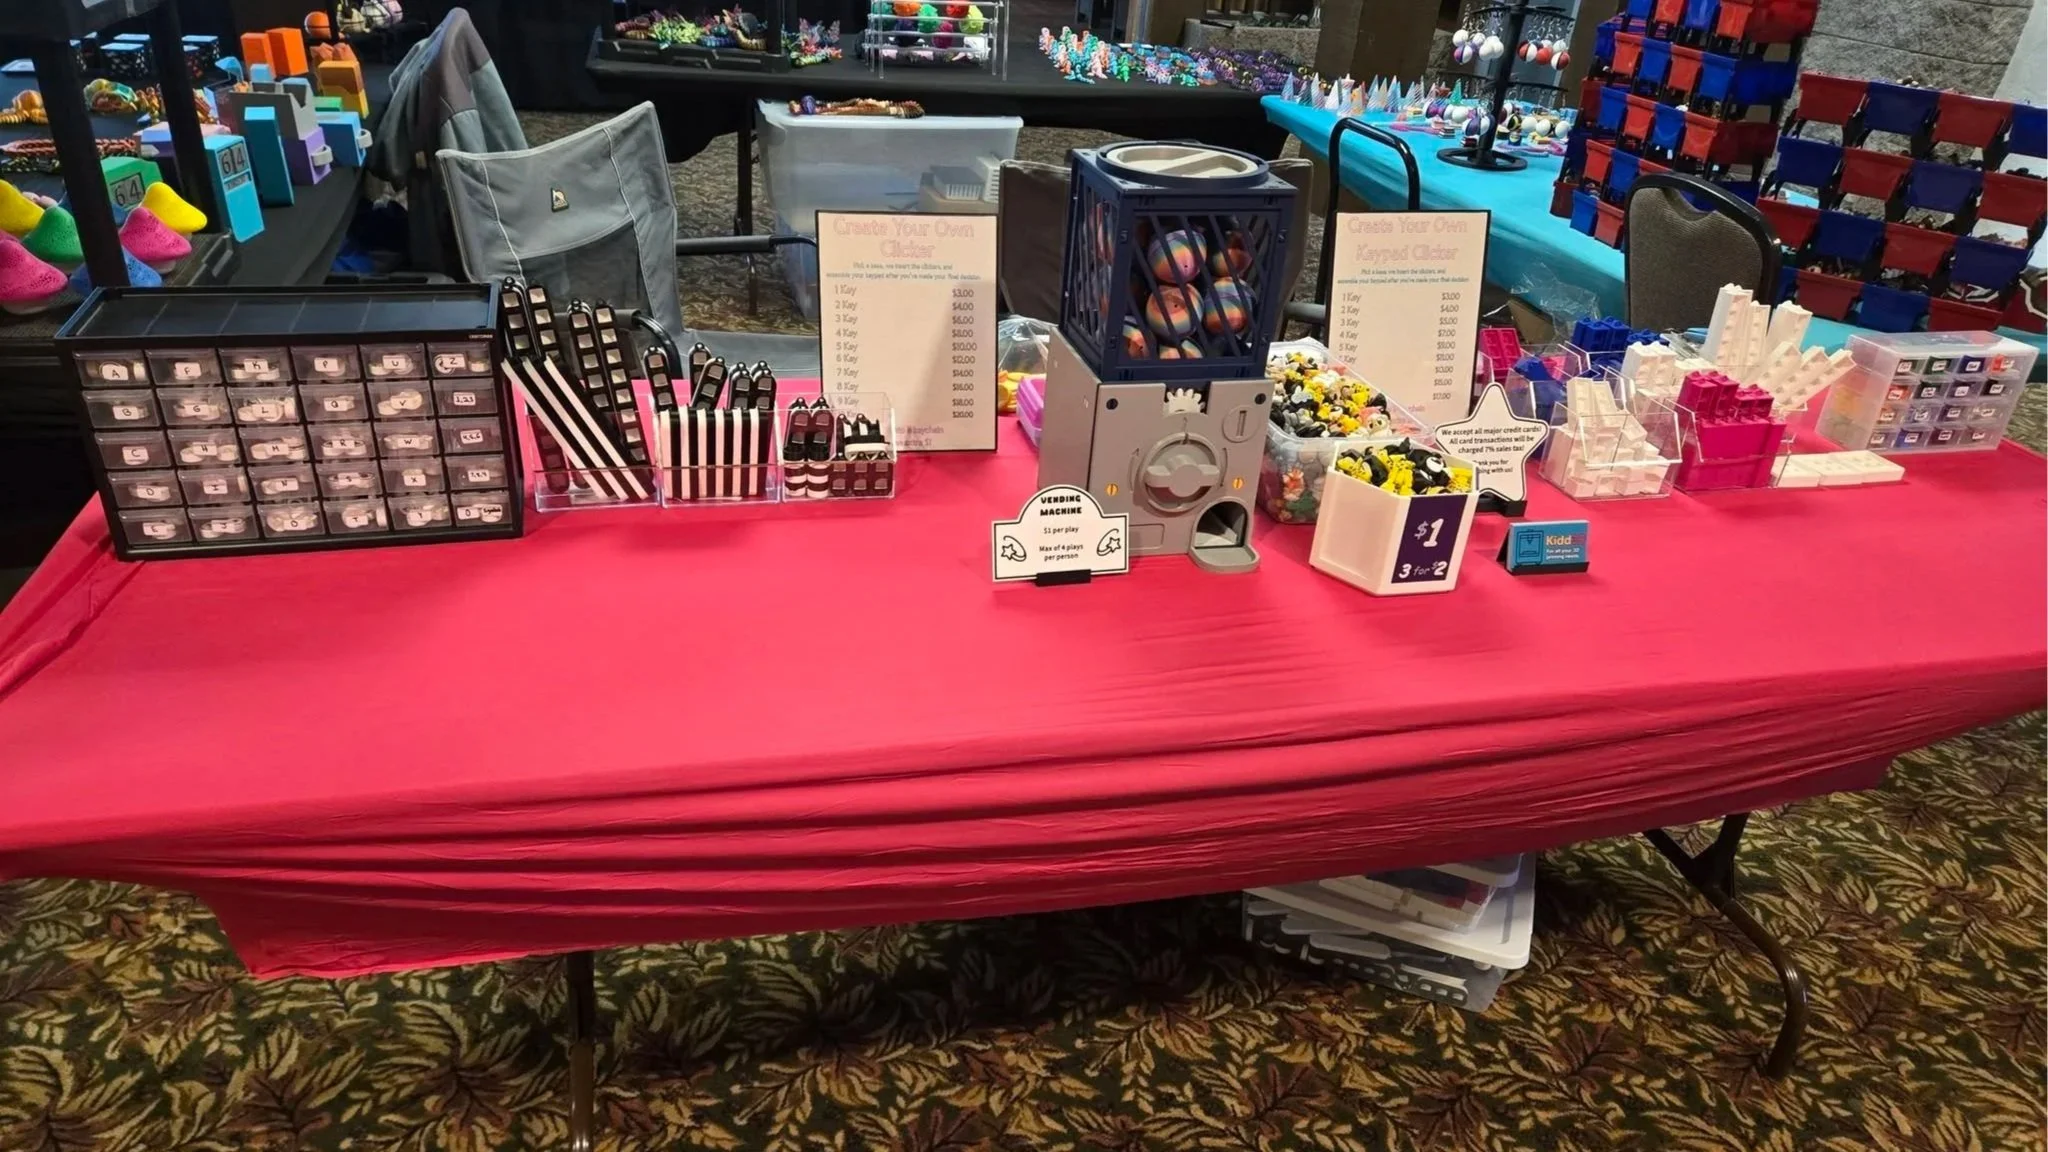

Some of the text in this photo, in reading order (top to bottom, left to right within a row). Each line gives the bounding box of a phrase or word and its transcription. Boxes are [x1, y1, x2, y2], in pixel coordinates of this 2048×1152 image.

[834, 218, 974, 238] Create Your Own
[1348, 216, 1467, 233] Create Your Own
[880, 240, 936, 258] Clicker
[1356, 244, 1457, 264] Keypad Clicker
[952, 289, 974, 298] $3.00
[952, 303, 974, 311] $4.00
[1440, 305, 1459, 313] $4.00
[252, 361, 261, 370] K
[322, 360, 328, 369] P
[449, 357, 458, 365] Z
[112, 369, 120, 378] A
[184, 366, 191, 375] F
[331, 401, 339, 409] Q
[122, 408, 131, 416] B
[262, 406, 269, 414] L
[1453, 428, 1473, 436] accept
[1484, 428, 1502, 436] major
[131, 449, 139, 458] C
[146, 488, 154, 496] D
[1041, 495, 1081, 504] VENDING
[1040, 507, 1082, 516] MACHINE
[220, 522, 228, 530] J
[1065, 526, 1079, 534] play
[1414, 518, 1444, 548] $1
[1546, 536, 1571, 545] Kidd
[1399, 561, 1448, 578] 3 for $2
